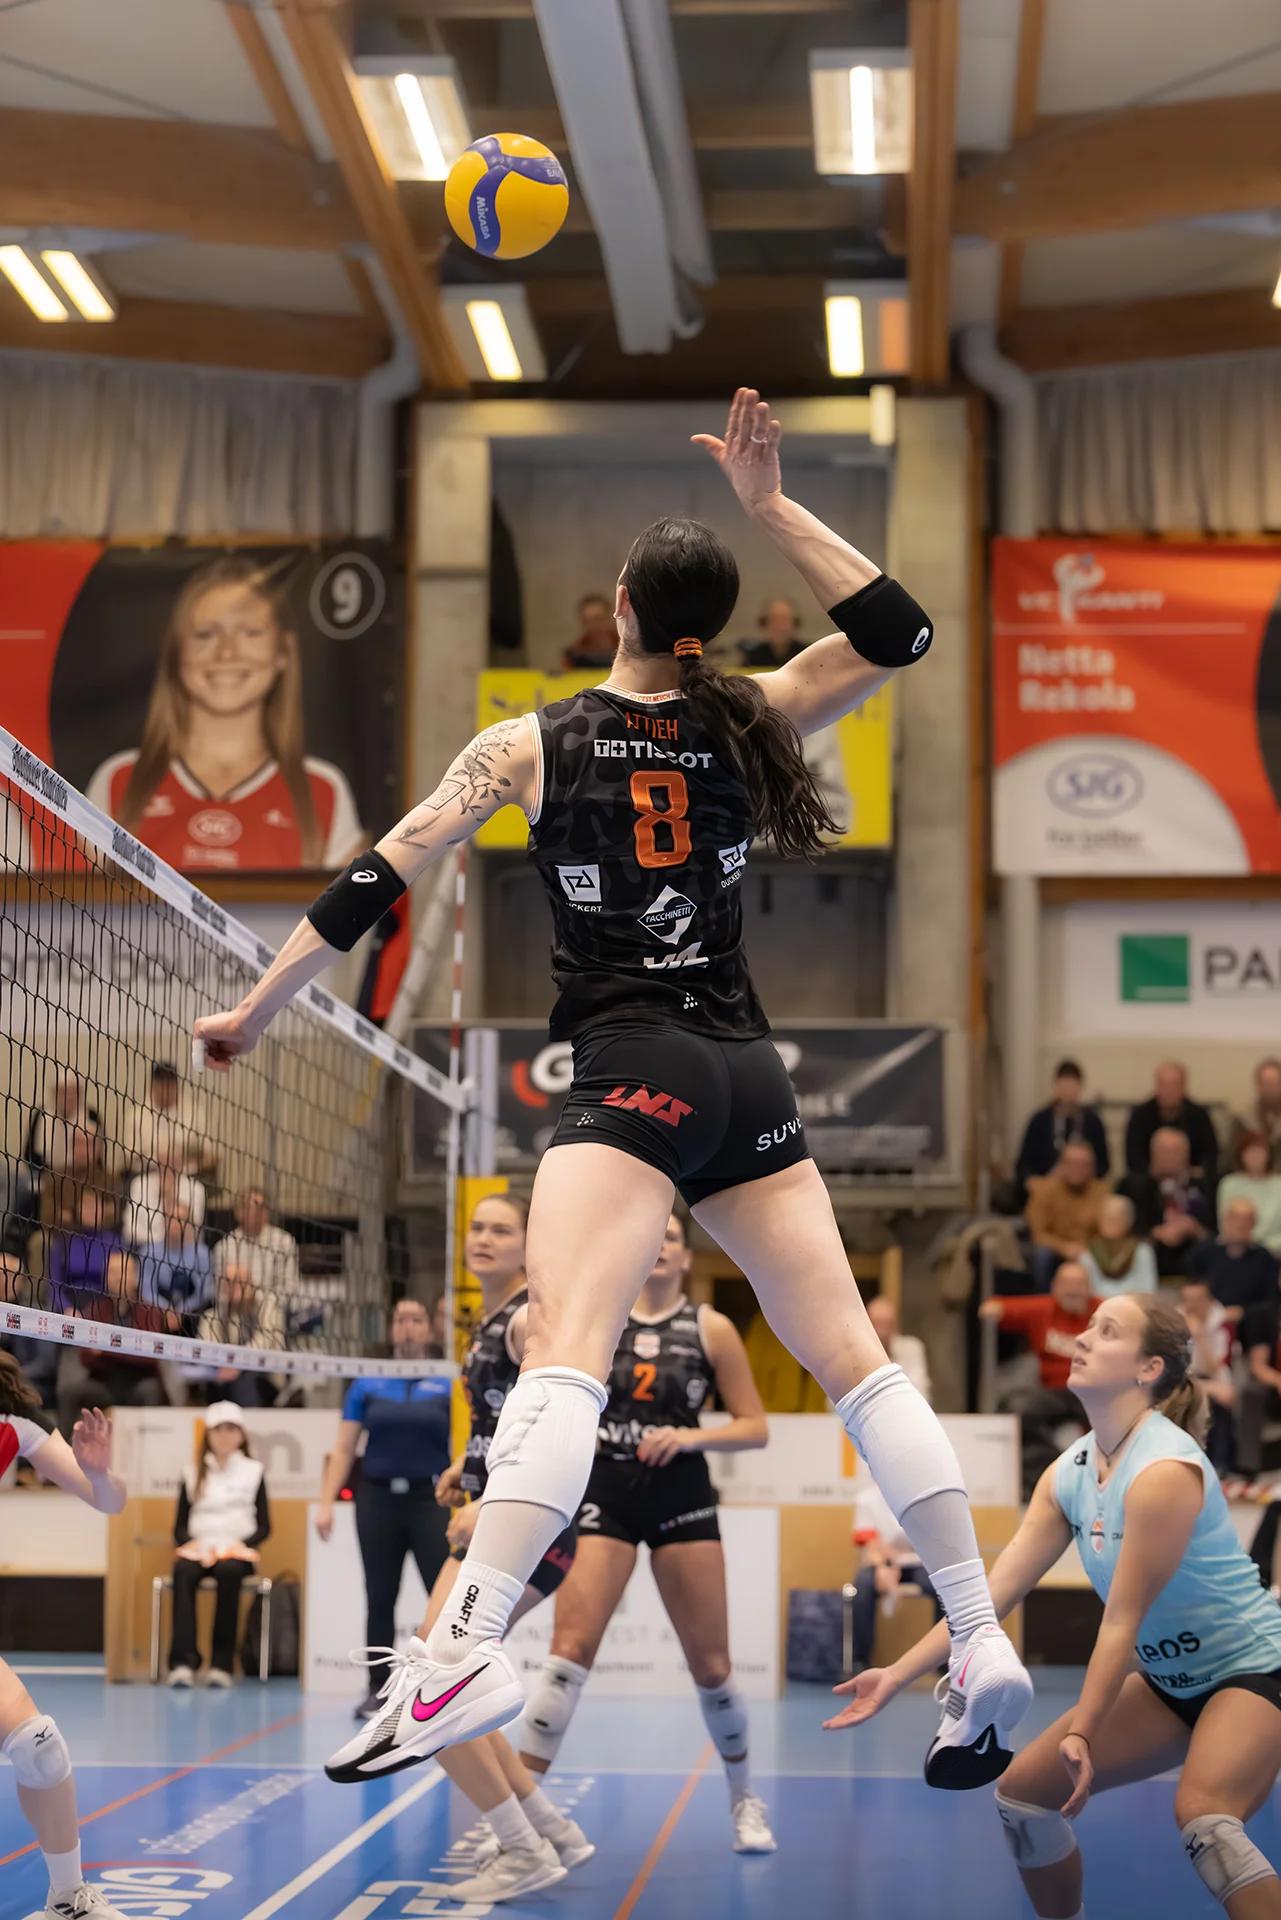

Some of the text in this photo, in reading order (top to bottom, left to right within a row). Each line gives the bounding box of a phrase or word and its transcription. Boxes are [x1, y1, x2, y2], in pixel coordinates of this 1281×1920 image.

[332, 569, 361, 623] 9
[629, 770, 692, 868] 8
[566, 902, 602, 912] CKERT
[645, 906, 691, 923] FACCHINETTI
[1204, 946, 1281, 991] PA
[632, 1363, 656, 1402] 2
[579, 1503, 601, 1529] 2
[459, 1584, 479, 1625] CRAFT
